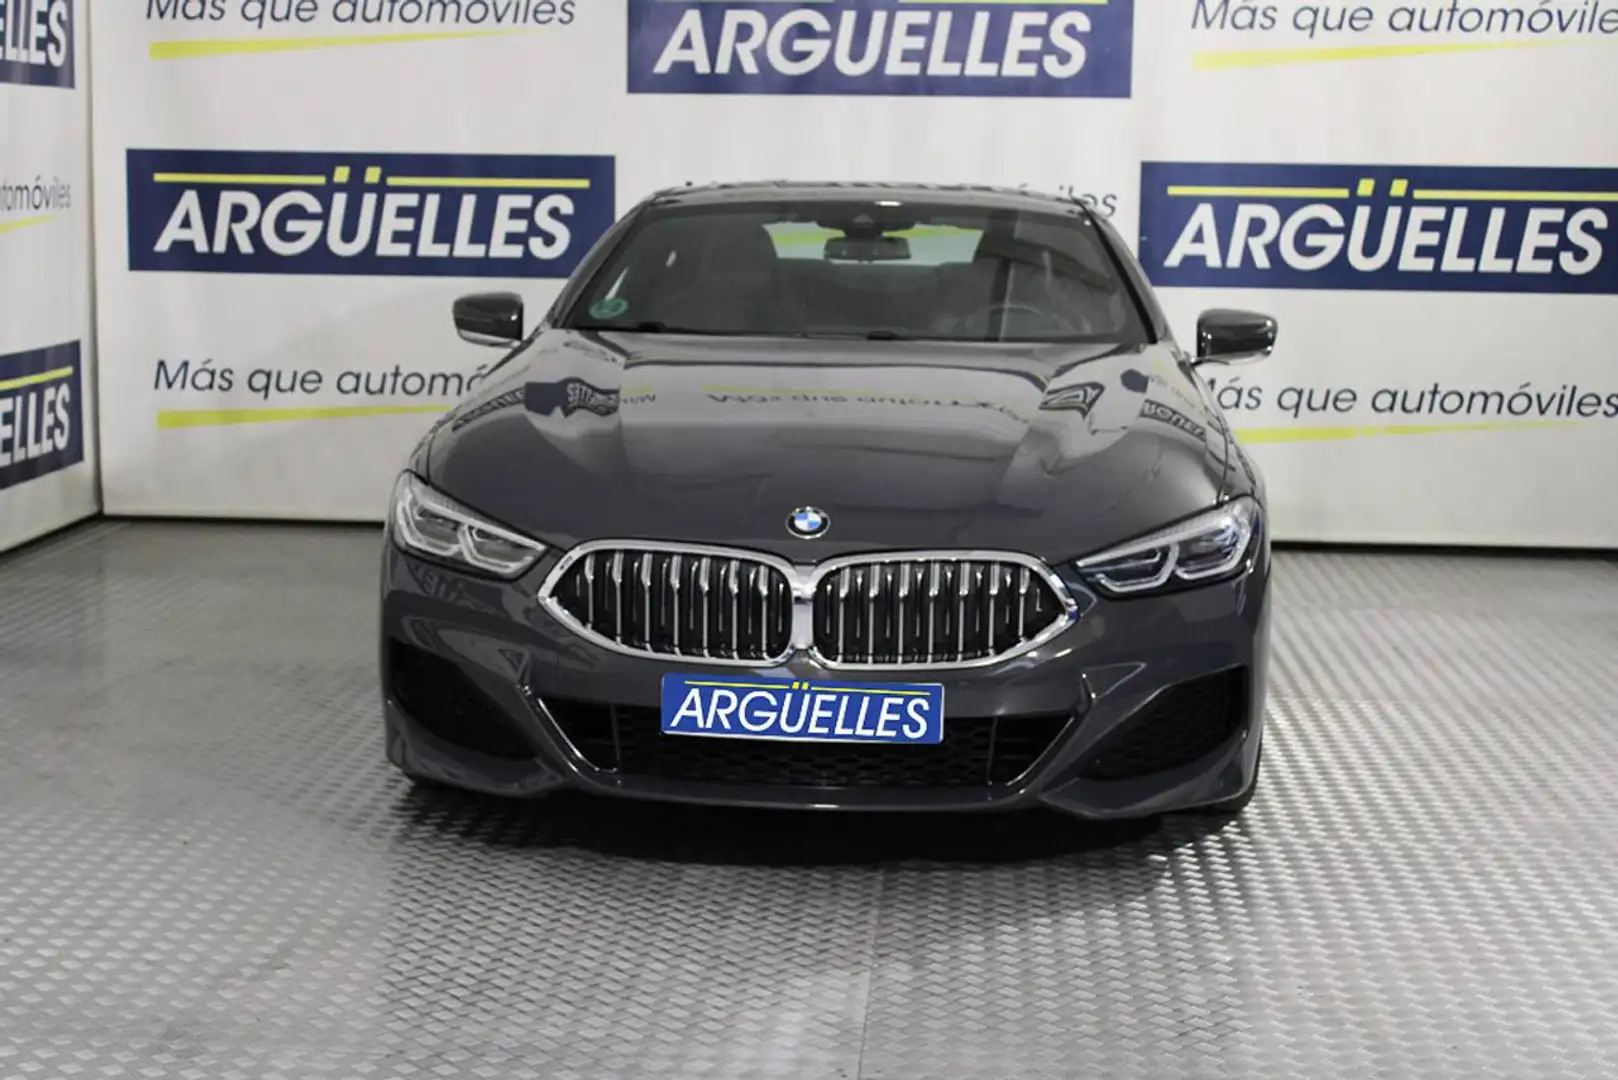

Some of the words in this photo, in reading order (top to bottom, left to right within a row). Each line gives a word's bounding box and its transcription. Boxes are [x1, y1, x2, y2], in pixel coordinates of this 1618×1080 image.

[240, 0, 319, 29] que
[1292, 6, 1374, 39] que
[153, 166, 575, 261] ARGÜELLES
[1163, 178, 1609, 276] ARGÜELLES
[153, 358, 235, 392] Más
[247, 368, 323, 400] que
[1207, 376, 1263, 411] ás
[1277, 386, 1358, 419] que
[1370, 382, 1618, 418] automóviles
[670, 682, 930, 739] ARGÜELLES
